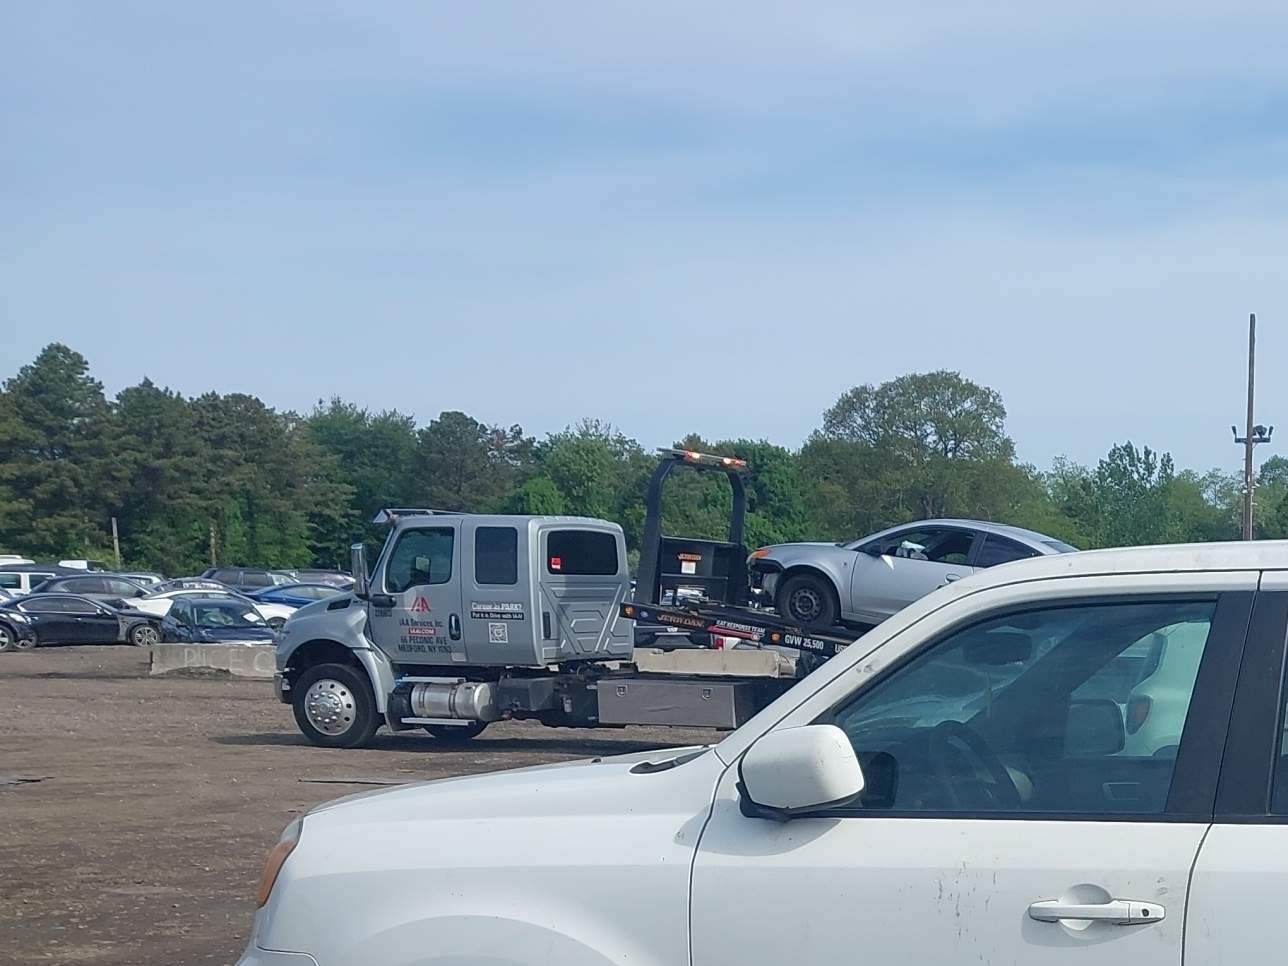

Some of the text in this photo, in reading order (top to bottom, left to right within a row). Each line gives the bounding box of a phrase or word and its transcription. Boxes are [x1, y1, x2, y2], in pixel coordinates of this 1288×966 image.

[752, 626, 766, 634] TEAM
[785, 634, 824, 651] GVW 25,500
